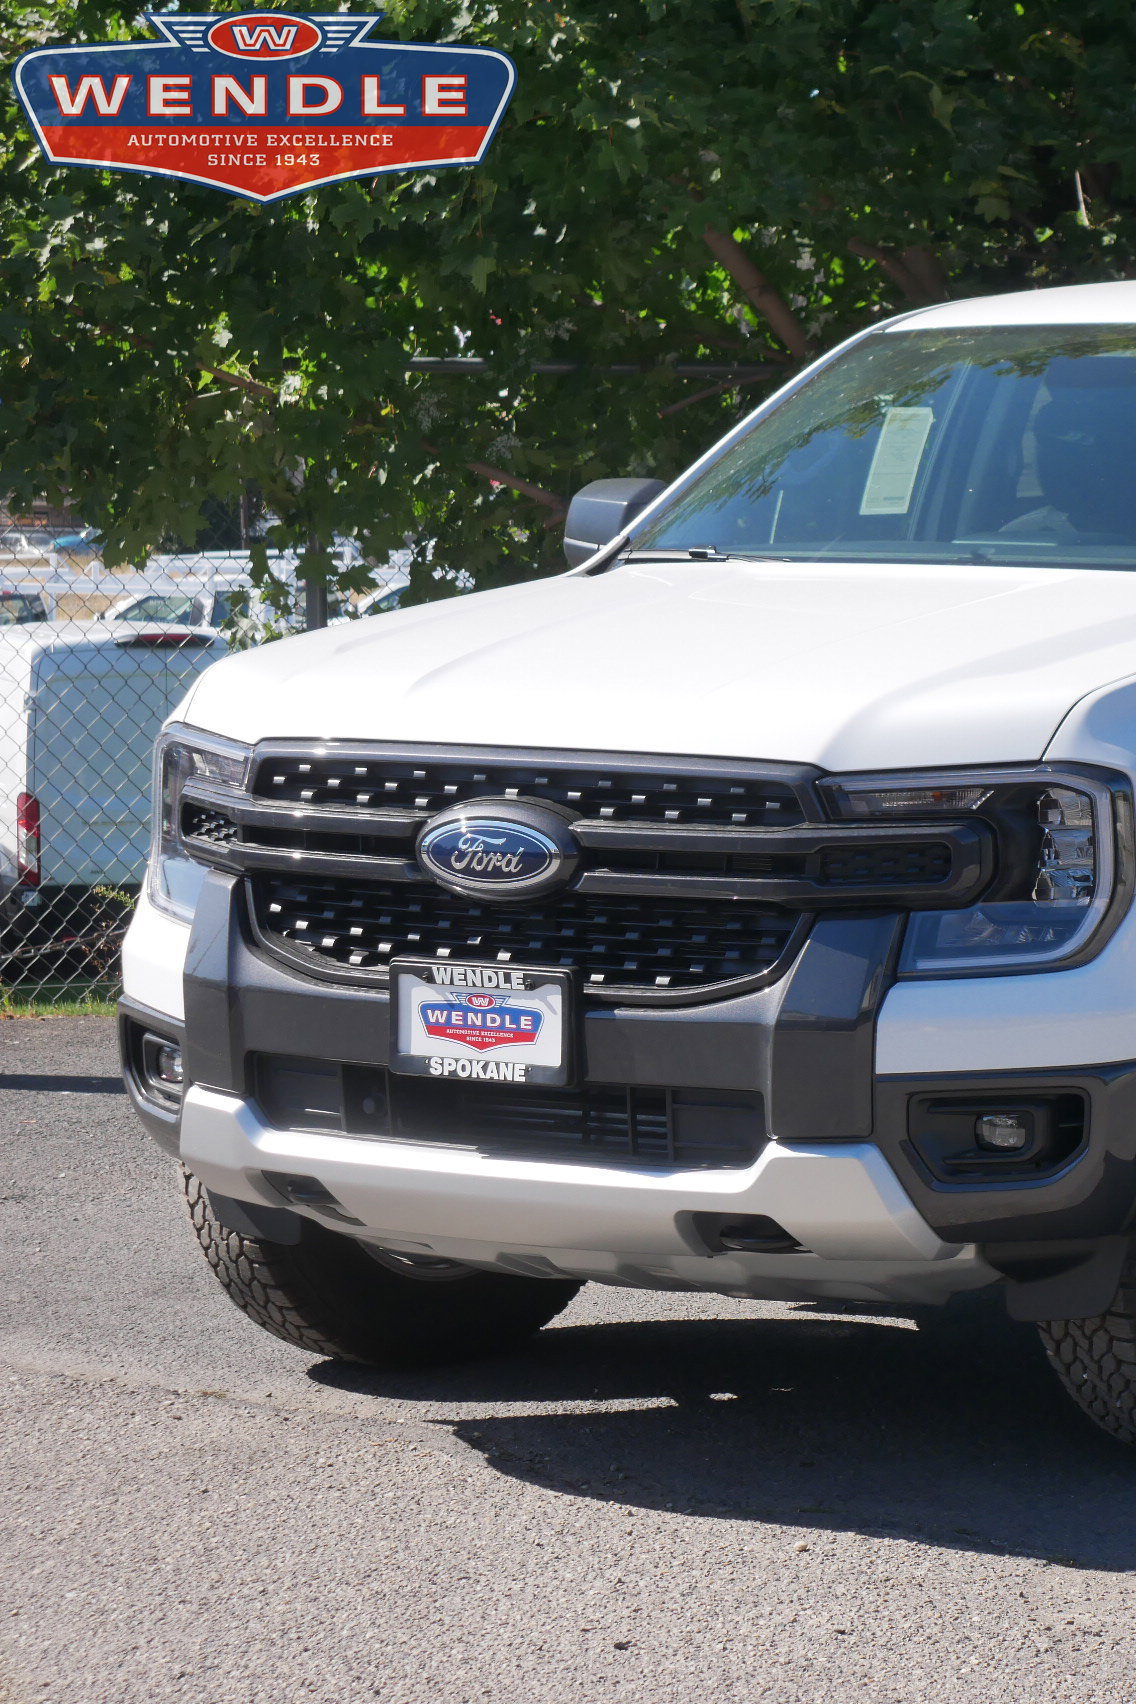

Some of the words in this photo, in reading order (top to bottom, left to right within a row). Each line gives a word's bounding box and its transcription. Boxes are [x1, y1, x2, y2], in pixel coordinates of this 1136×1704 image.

[451, 833, 525, 873] Ford
[432, 966, 525, 990] WENDLE
[426, 1009, 533, 1030] WENDLE
[446, 1028, 480, 1036] AUTOMOTIVE
[429, 1056, 526, 1082] SPOKANE
